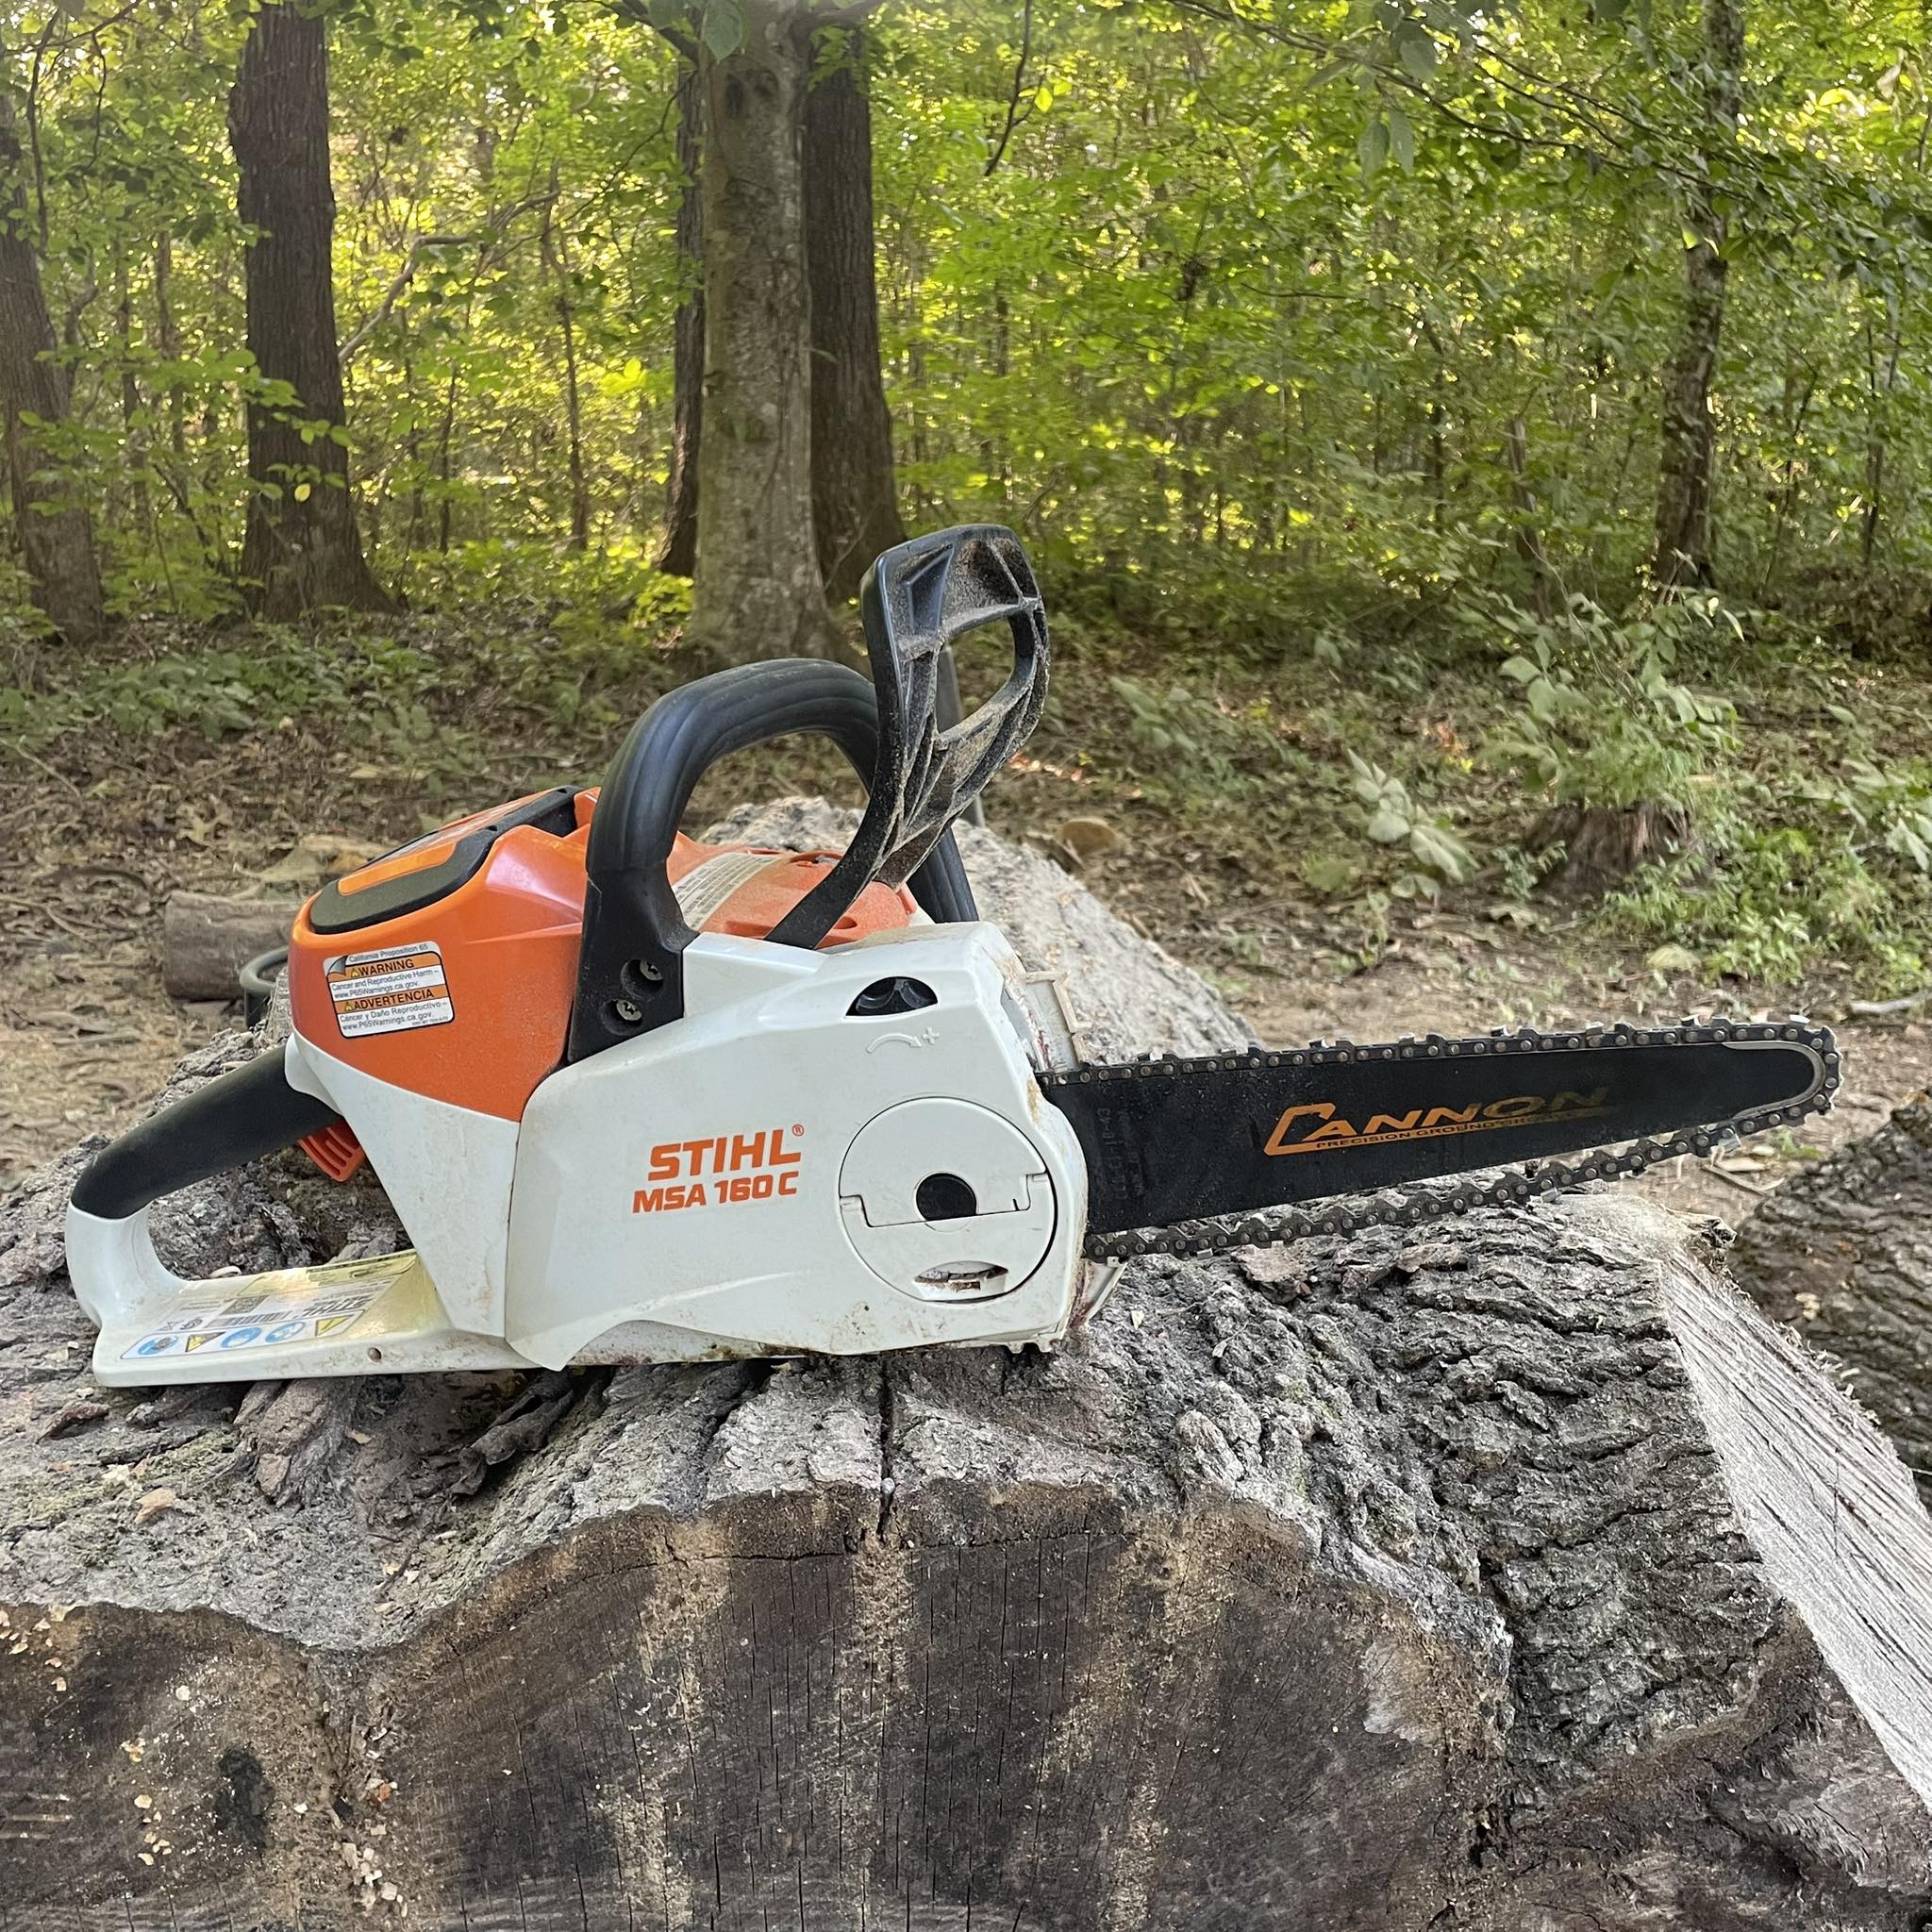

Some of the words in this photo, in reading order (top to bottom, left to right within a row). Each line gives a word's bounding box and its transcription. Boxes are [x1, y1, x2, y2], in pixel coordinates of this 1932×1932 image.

[380, 946, 418, 958] Proposition
[358, 958, 415, 976] WARNING
[332, 982, 354, 991] Cancer
[355, 979, 367, 988] and
[368, 973, 412, 987] Reproductive
[413, 969, 434, 977] Harm
[354, 989, 435, 1010] ADVERTENCIA
[371, 1008, 391, 1019] Daño
[391, 1000, 441, 1016] Reproductivo
[1263, 1088, 1609, 1156] CANNON
[1317, 1131, 1412, 1148] PRECISION
[1416, 1121, 1495, 1137] GROUND
[633, 1183, 708, 1214] MSA
[713, 1174, 774, 1205] 160
[778, 1171, 800, 1196] C
